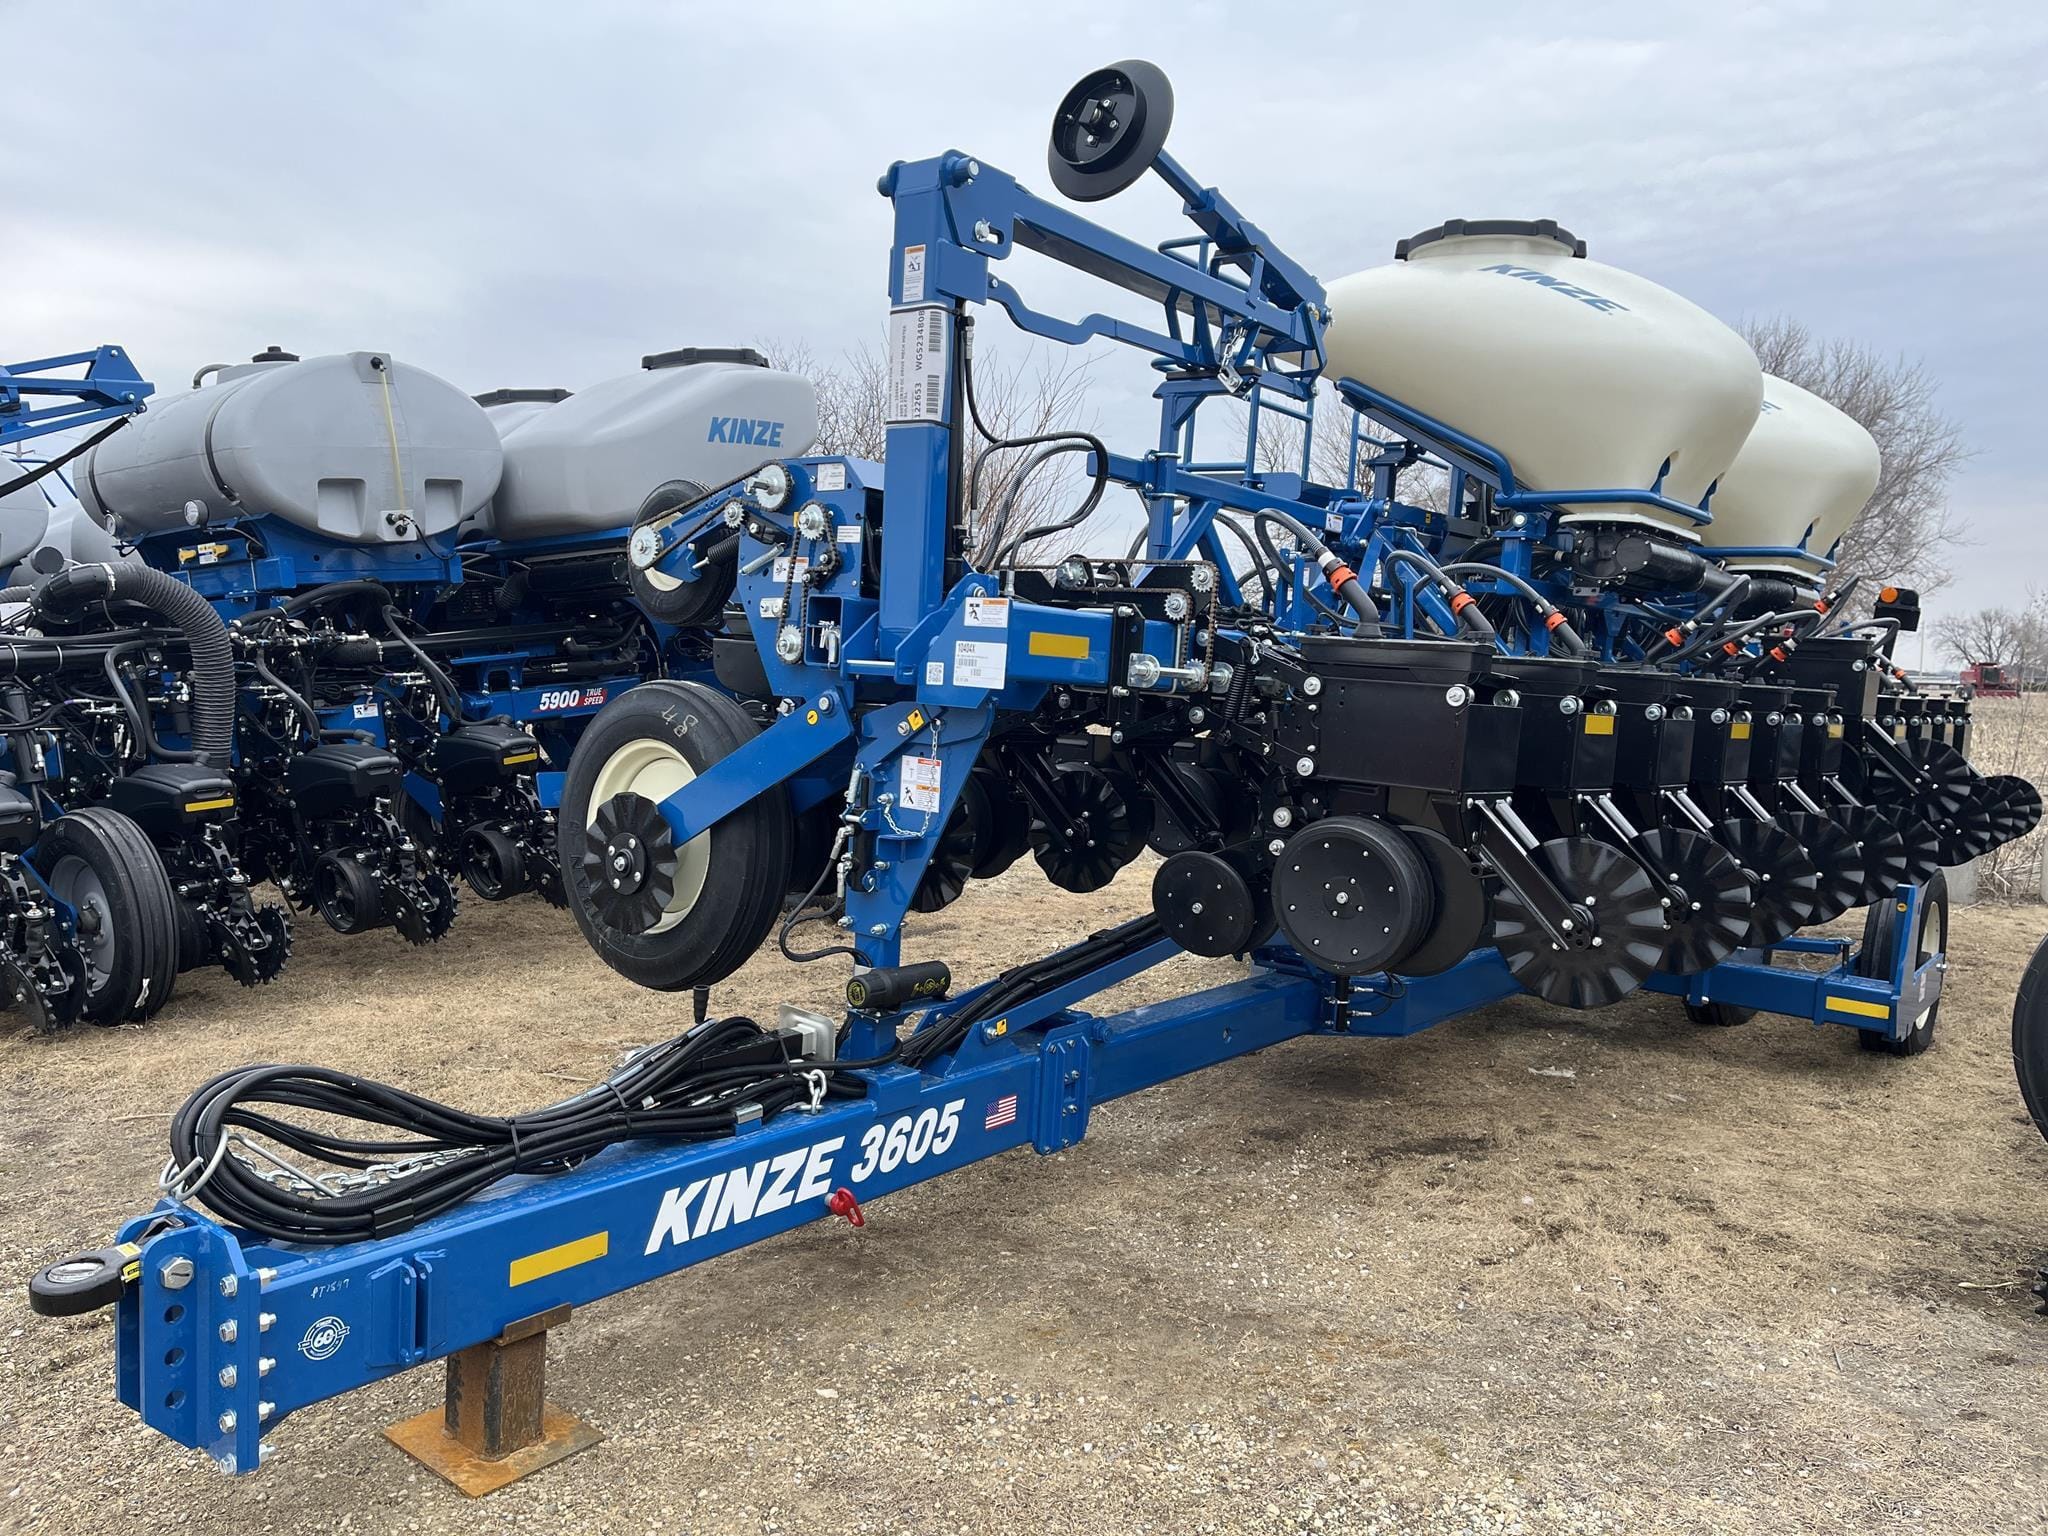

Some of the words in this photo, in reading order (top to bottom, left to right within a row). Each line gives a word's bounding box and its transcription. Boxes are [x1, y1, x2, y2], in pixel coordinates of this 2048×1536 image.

[1477, 264, 1631, 312] KINZE
[914, 382, 922, 418] 122653
[707, 416, 784, 447] KINZE
[540, 690, 580, 710] 5900
[584, 696, 604, 706] SPEED
[586, 688, 603, 697] TRUE
[644, 1136, 845, 1256] KINZE
[851, 1098, 966, 1183] 3605
[313, 1329, 334, 1348] 60
